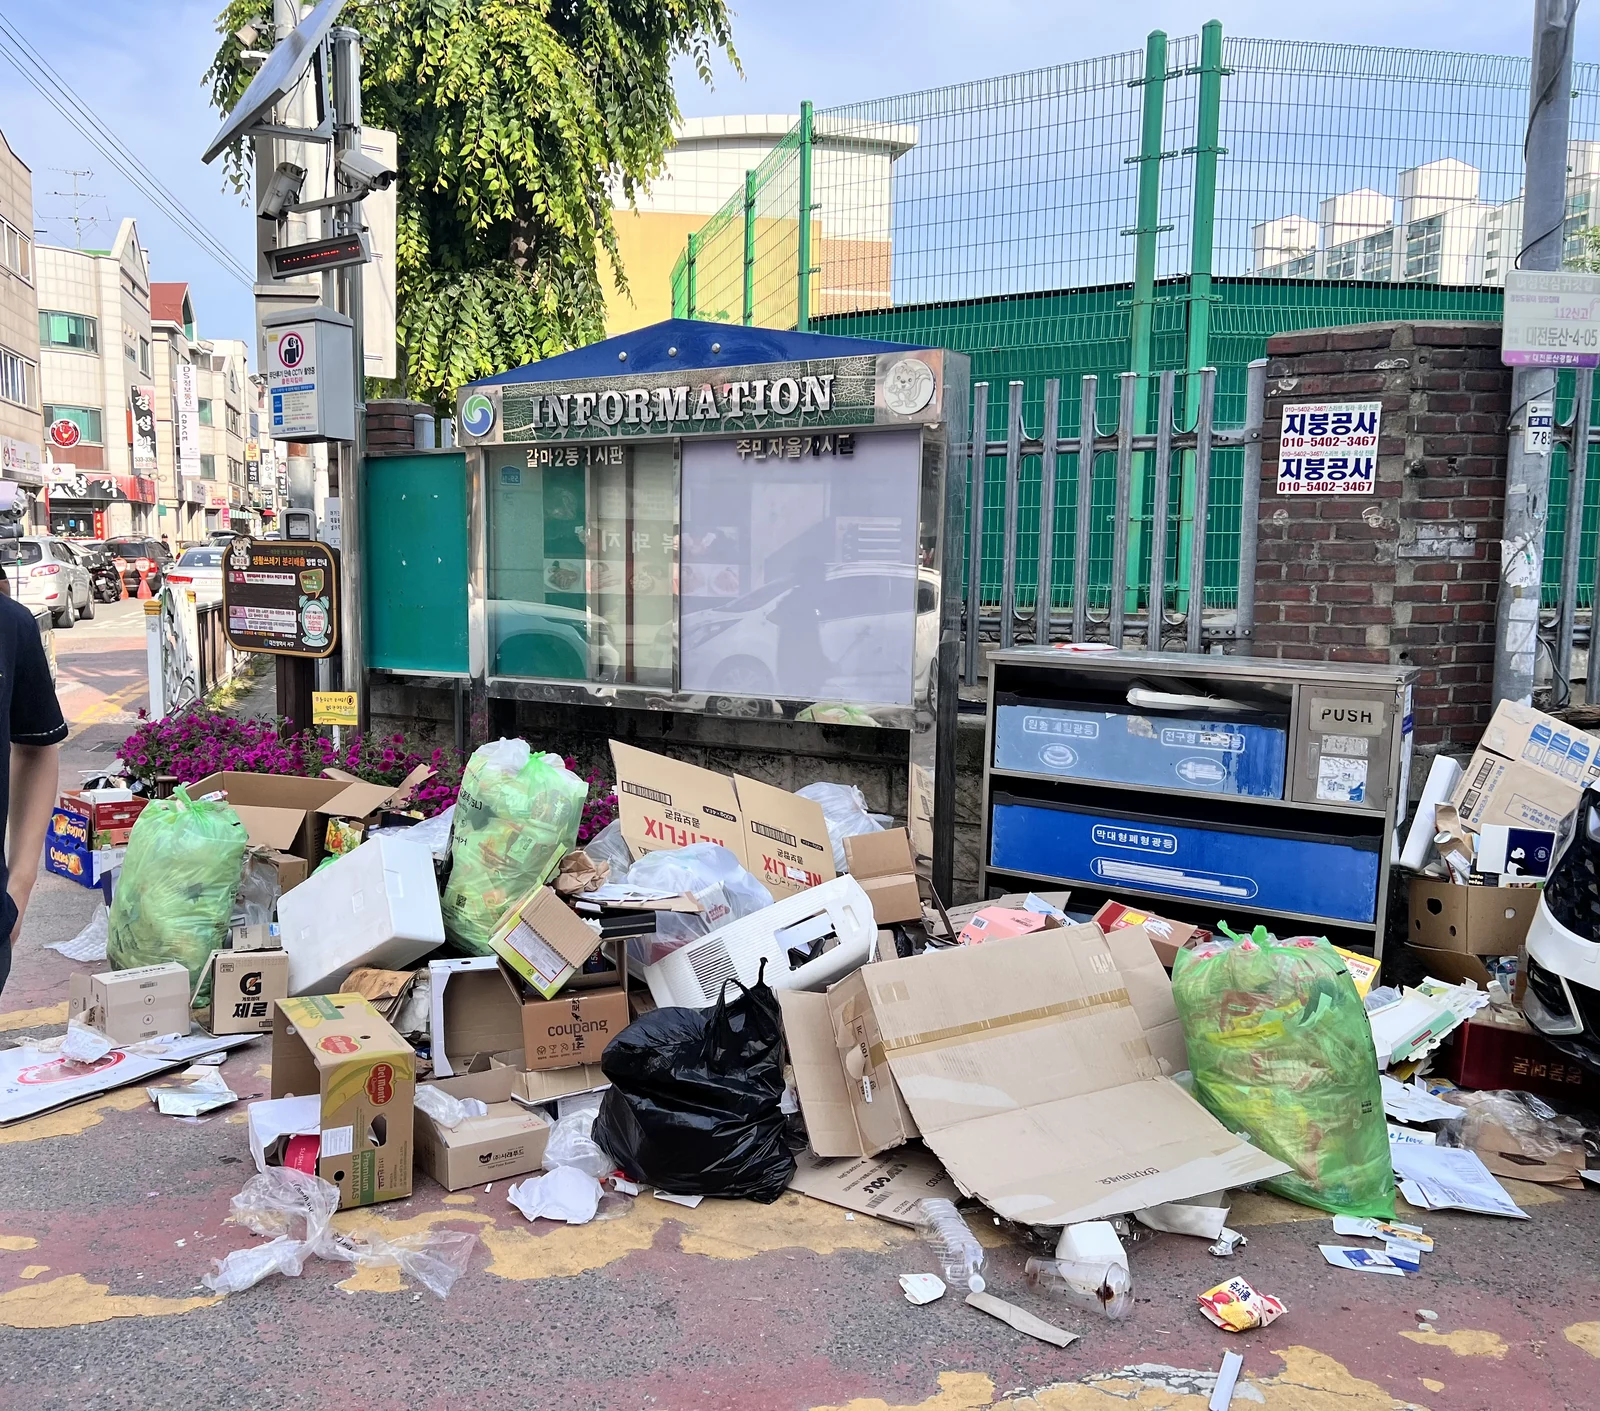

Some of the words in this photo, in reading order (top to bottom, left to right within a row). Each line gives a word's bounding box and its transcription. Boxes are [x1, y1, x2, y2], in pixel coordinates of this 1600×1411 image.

[1554, 307, 1589, 320] 112신고
[1526, 326, 1598, 346] 대전둔산-4-05
[292, 368, 304, 377] CCTV
[531, 375, 836, 429] INFORMATION
[1283, 411, 1377, 436] 지붕공사
[1530, 417, 1552, 426] 갈마
[1282, 436, 1377, 448] 010-5402-3467
[526, 448, 580, 468] 갈마2동
[1279, 457, 1373, 481] 지붕공사
[1278, 481, 1373, 492] 010-5402-3467
[252, 555, 281, 566] 생활쓰레기
[282, 556, 306, 567] 분리배출
[306, 558, 316, 567] 방법
[317, 558, 328, 567] 안내
[1321, 708, 1373, 724] PUSH
[1164, 731, 1196, 744] 전구형
[50, 846, 69, 865] Cuties
[239, 971, 262, 996] G
[232, 1002, 268, 1019] 제로
[547, 1019, 609, 1038] coupang
[377, 1066, 387, 1078] Del
[377, 1078, 387, 1103] Monte
[297, 1147, 306, 1166] SUSHI
[352, 1153, 360, 1200] BANANAS
[362, 1152, 372, 1192] Premium
[1229, 1280, 1252, 1302] 쥬시쿨
